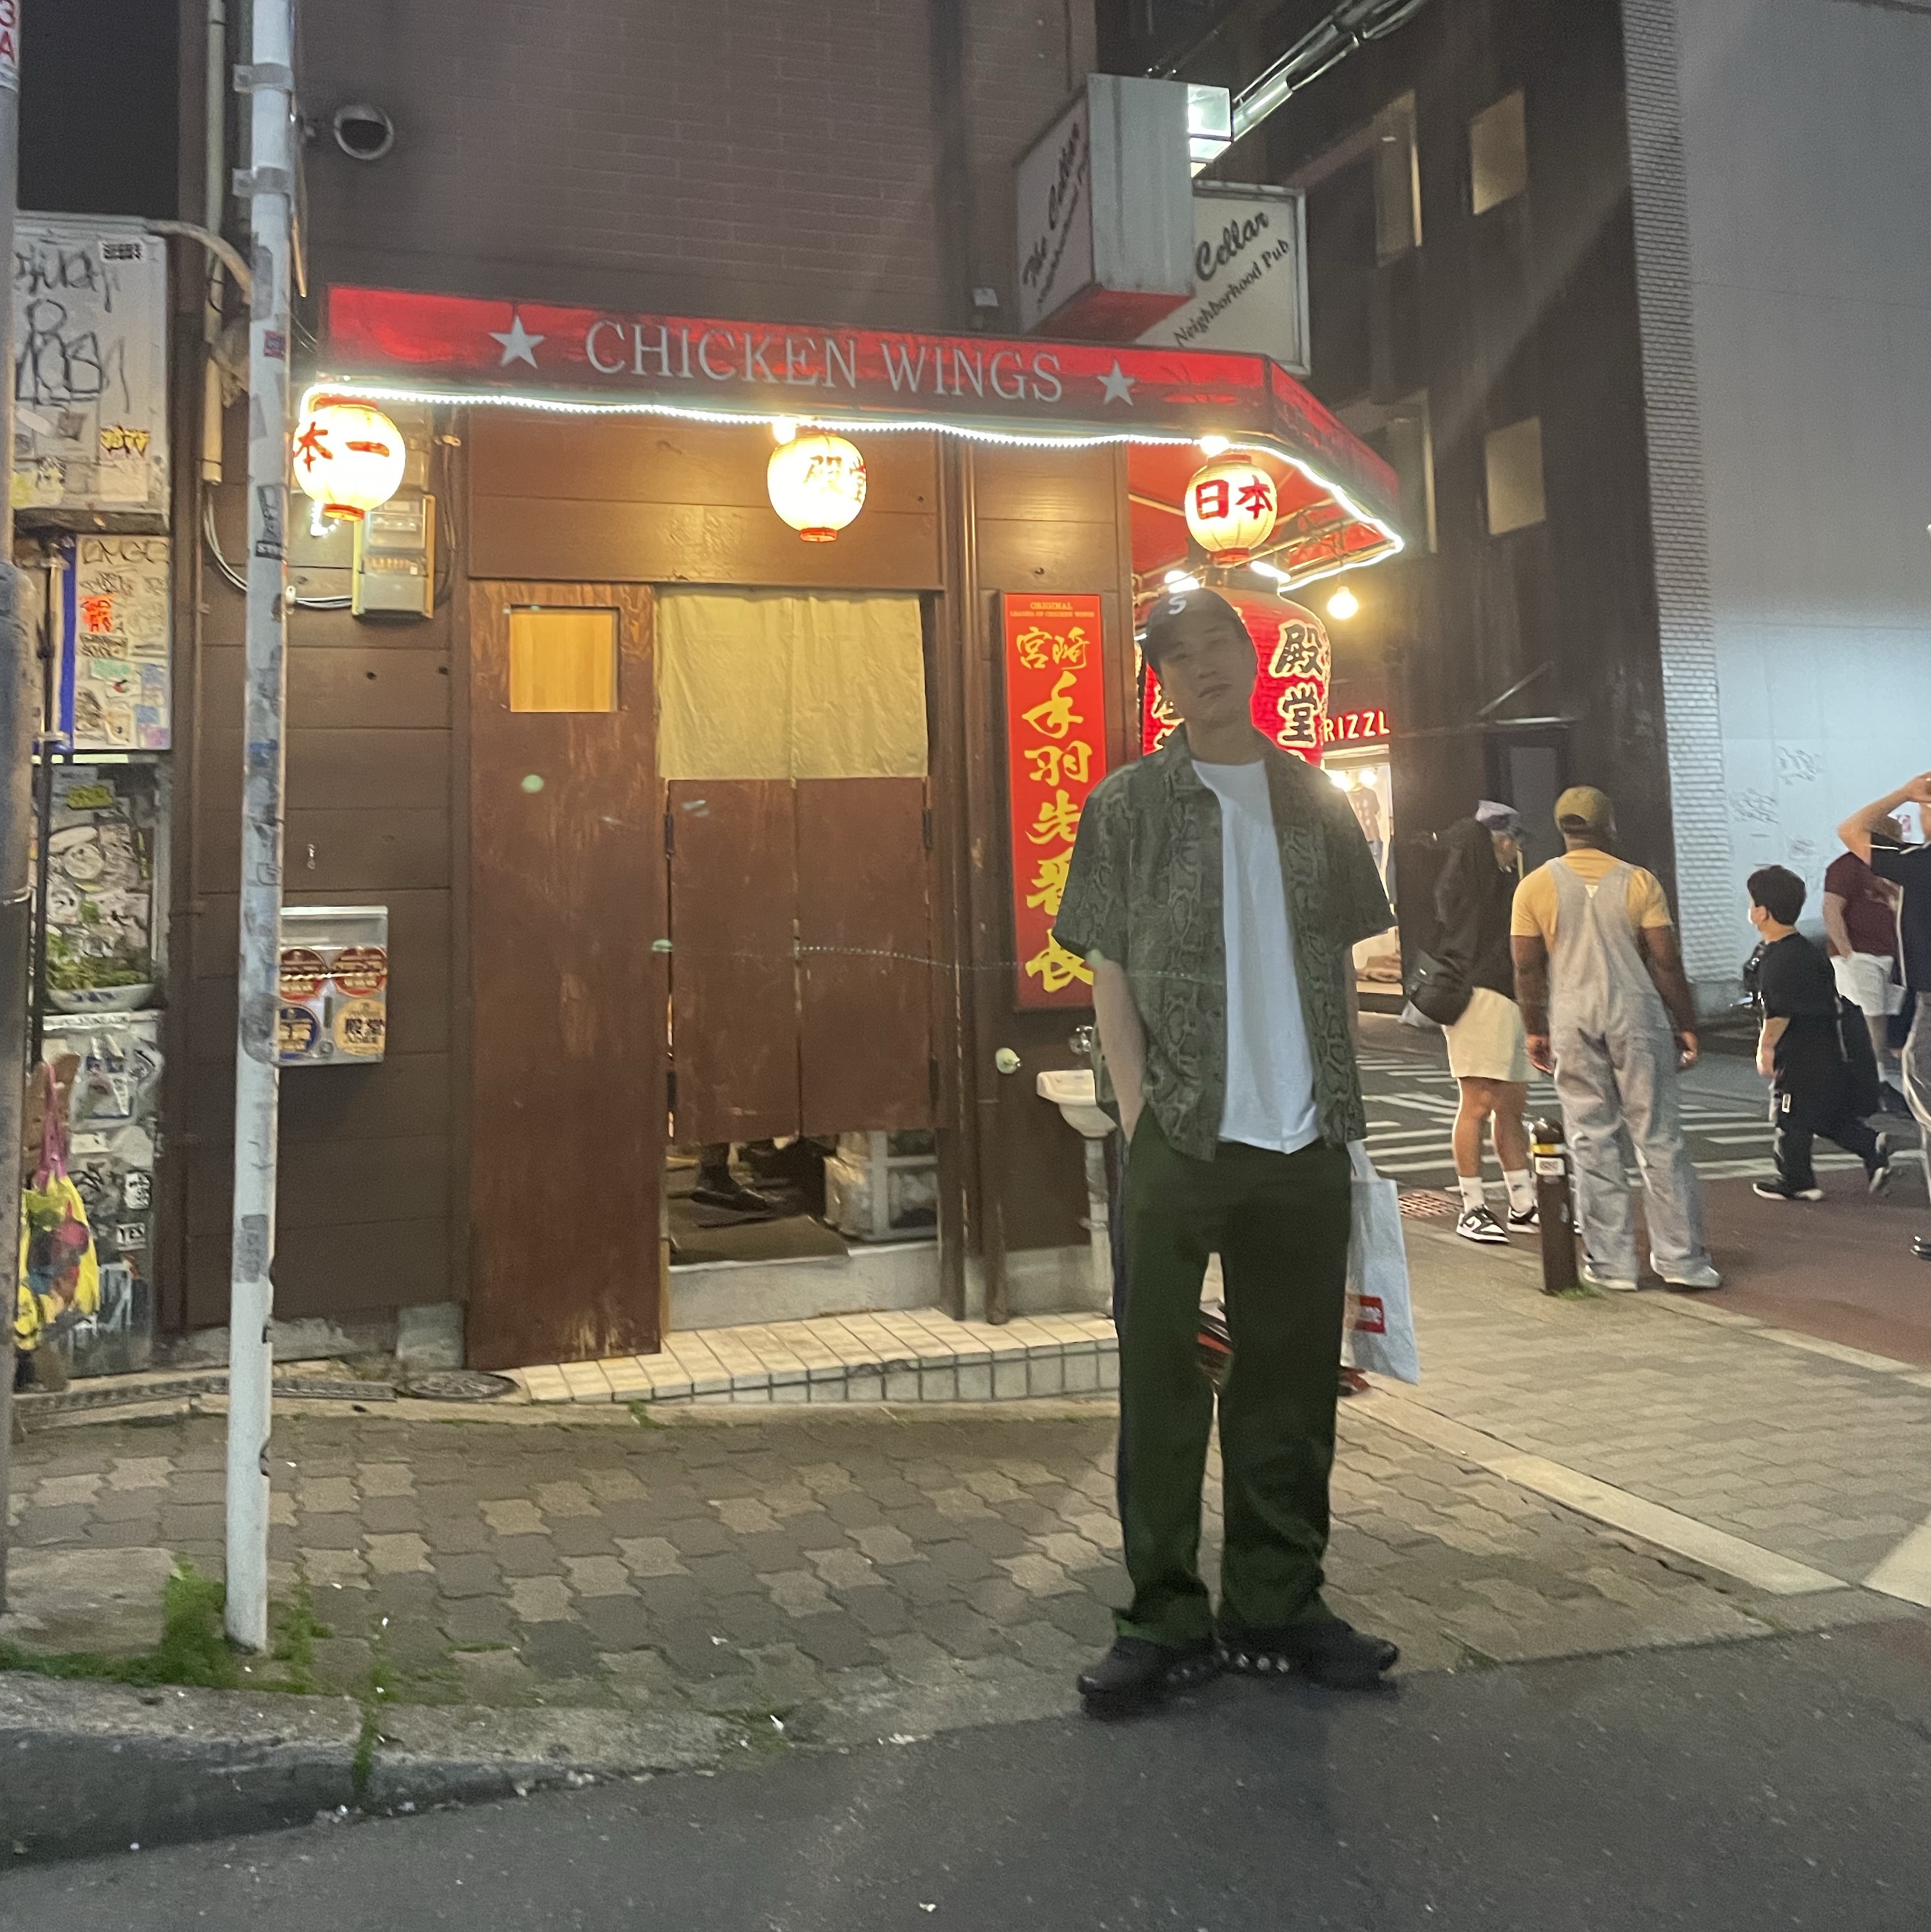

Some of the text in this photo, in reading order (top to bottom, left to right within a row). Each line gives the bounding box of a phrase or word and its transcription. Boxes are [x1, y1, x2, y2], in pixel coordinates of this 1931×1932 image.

[1196, 211, 1269, 282] Cellar
[1174, 239, 1289, 347] Neighborhood Pub
[586, 320, 1062, 402] CHICKEN WINGS
[1195, 475, 1273, 520] 日本
[1168, 595, 1187, 614] S
[1016, 627, 1090, 670] 宮崎
